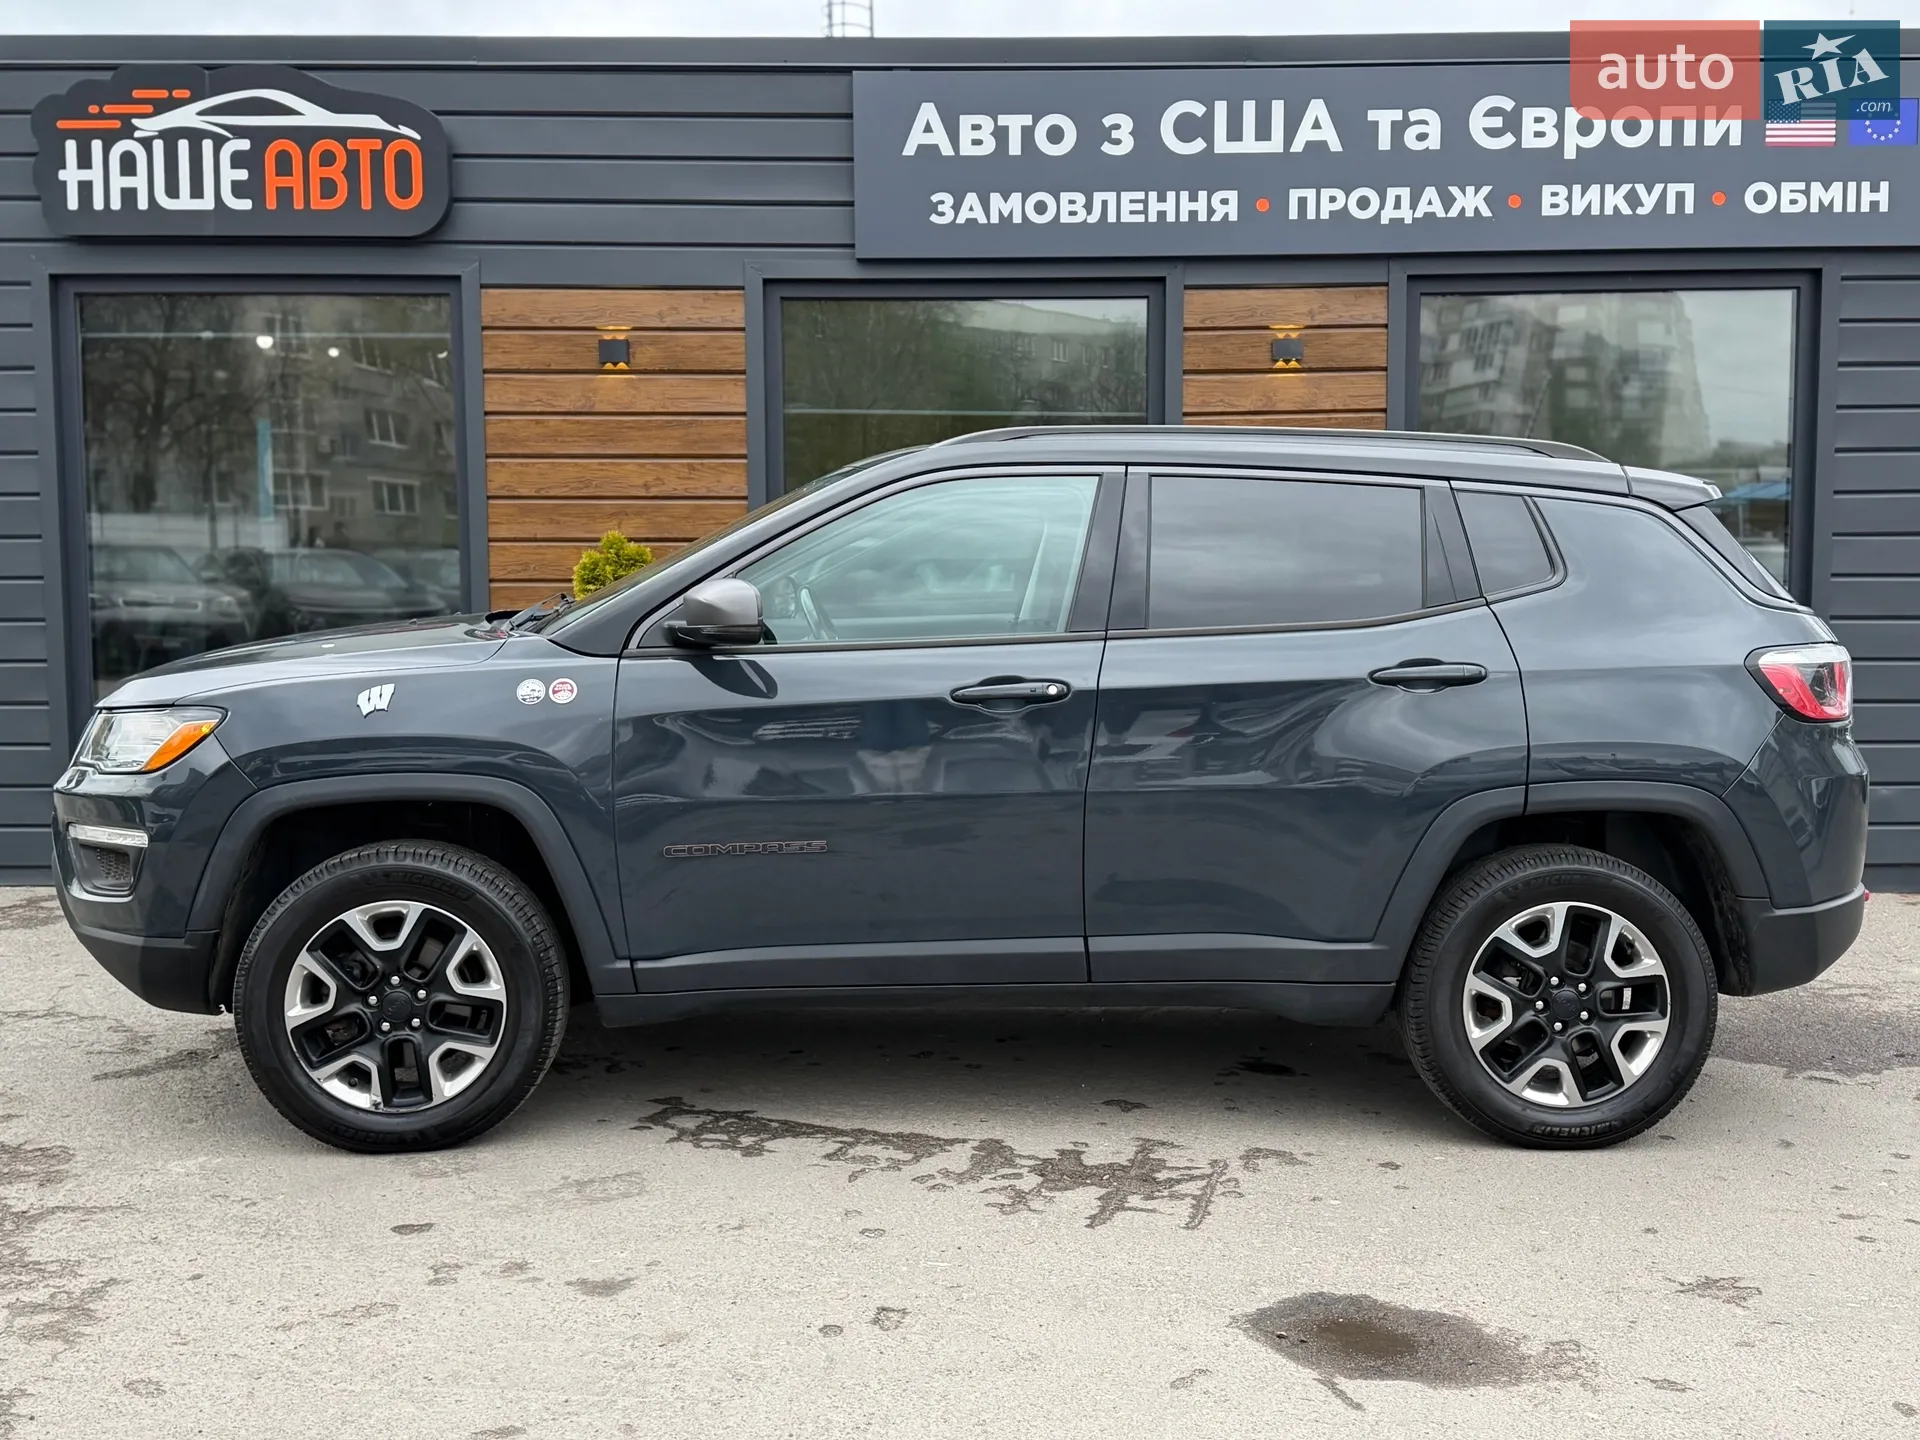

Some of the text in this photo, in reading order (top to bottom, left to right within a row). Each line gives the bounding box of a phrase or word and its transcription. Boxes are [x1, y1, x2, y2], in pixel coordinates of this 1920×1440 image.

[902, 94, 1743, 160] Авто з США та Європи
[58, 138, 424, 211] НАШЕ АВТО
[929, 180, 1890, 226] ЗАМОВЛЕННЯ ПРОДАЖ ВИКУП ОБМІН
[663, 840, 828, 858] COMPASS
